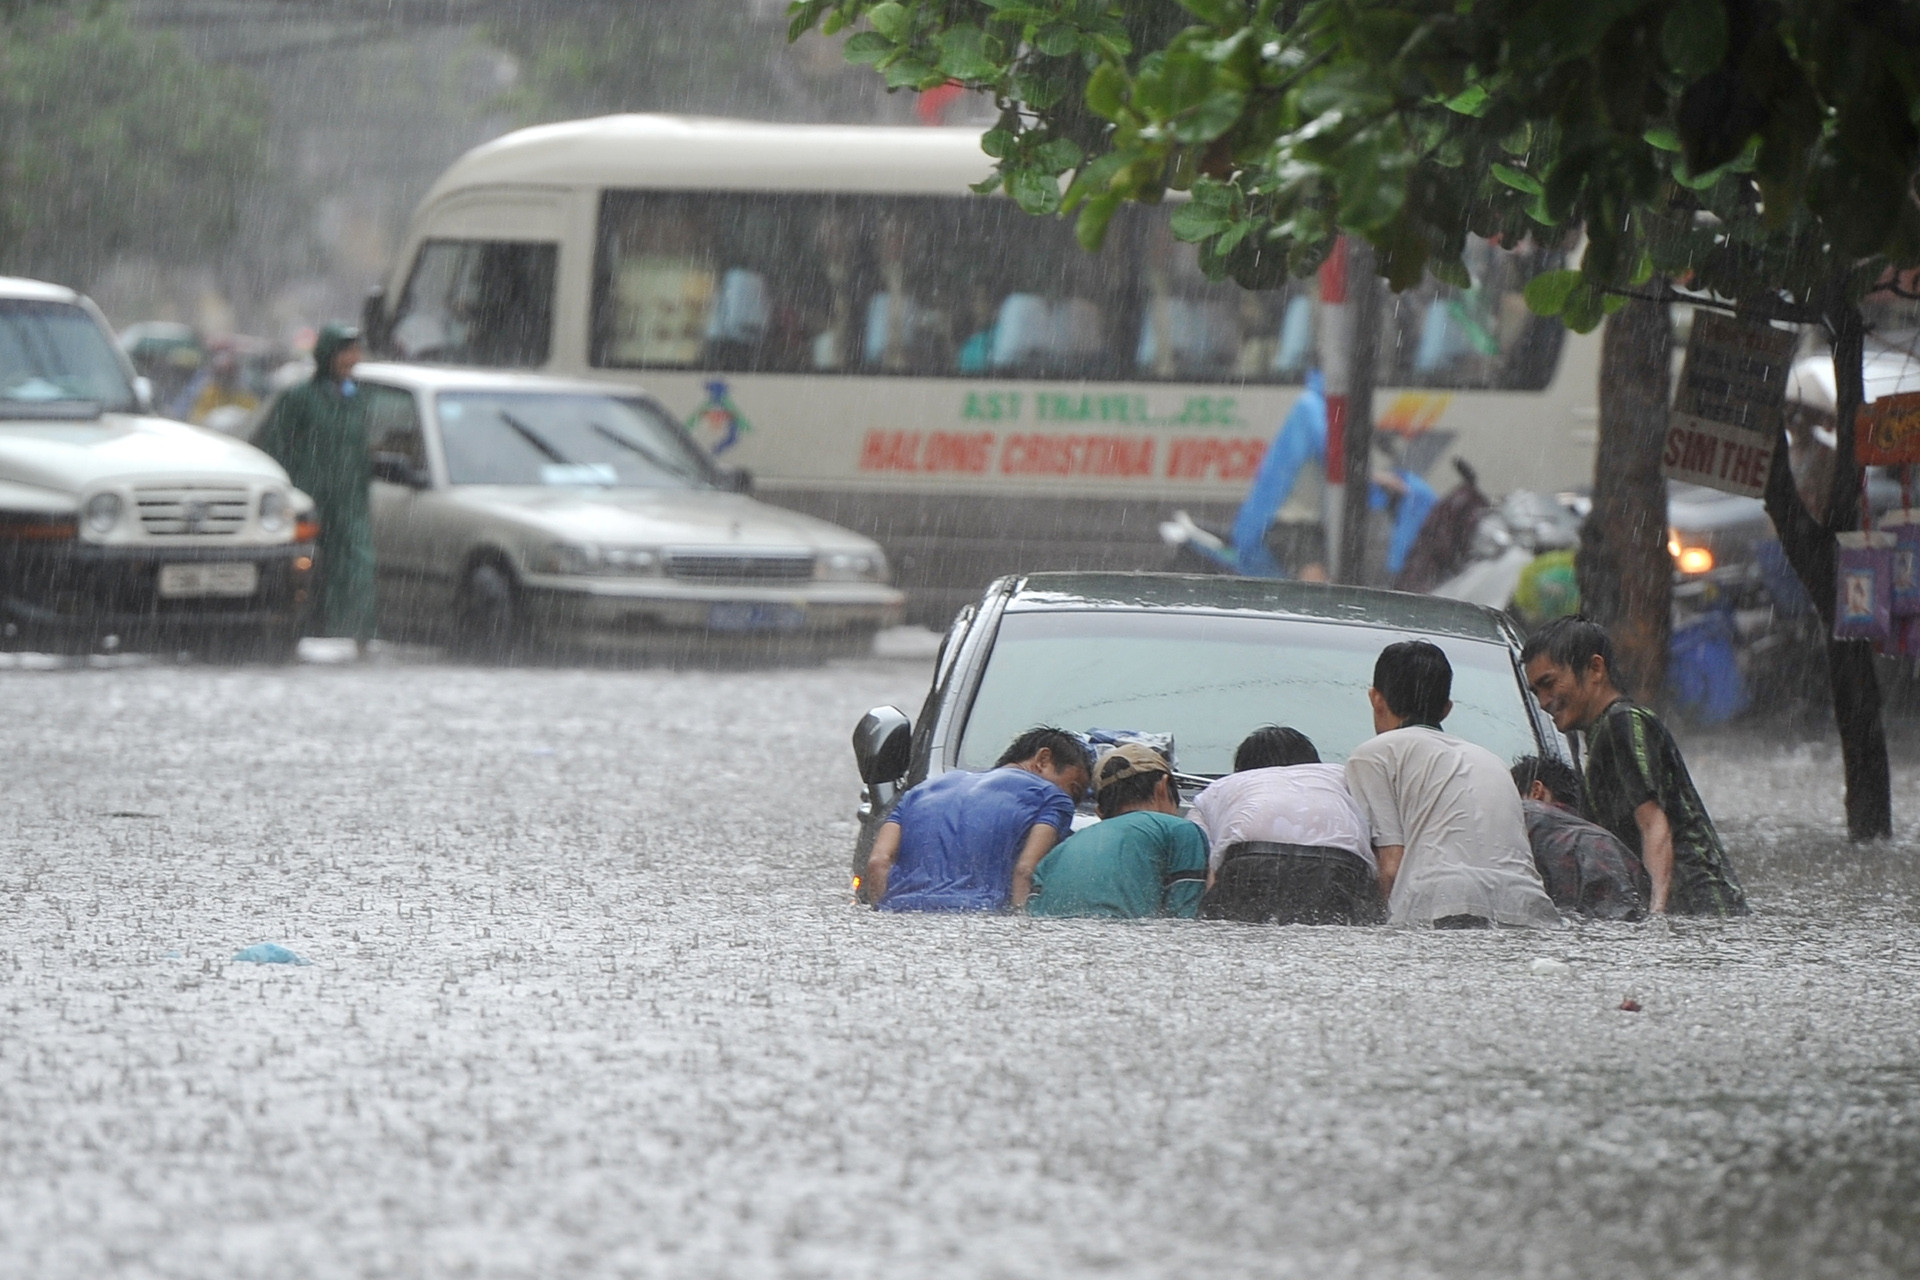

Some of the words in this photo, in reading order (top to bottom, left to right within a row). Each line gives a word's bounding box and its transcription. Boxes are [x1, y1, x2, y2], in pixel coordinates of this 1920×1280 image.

[960, 391, 1022, 420] AST
[860, 428, 995, 475] HALONG
[1000, 431, 1157, 479] CRISTINA
